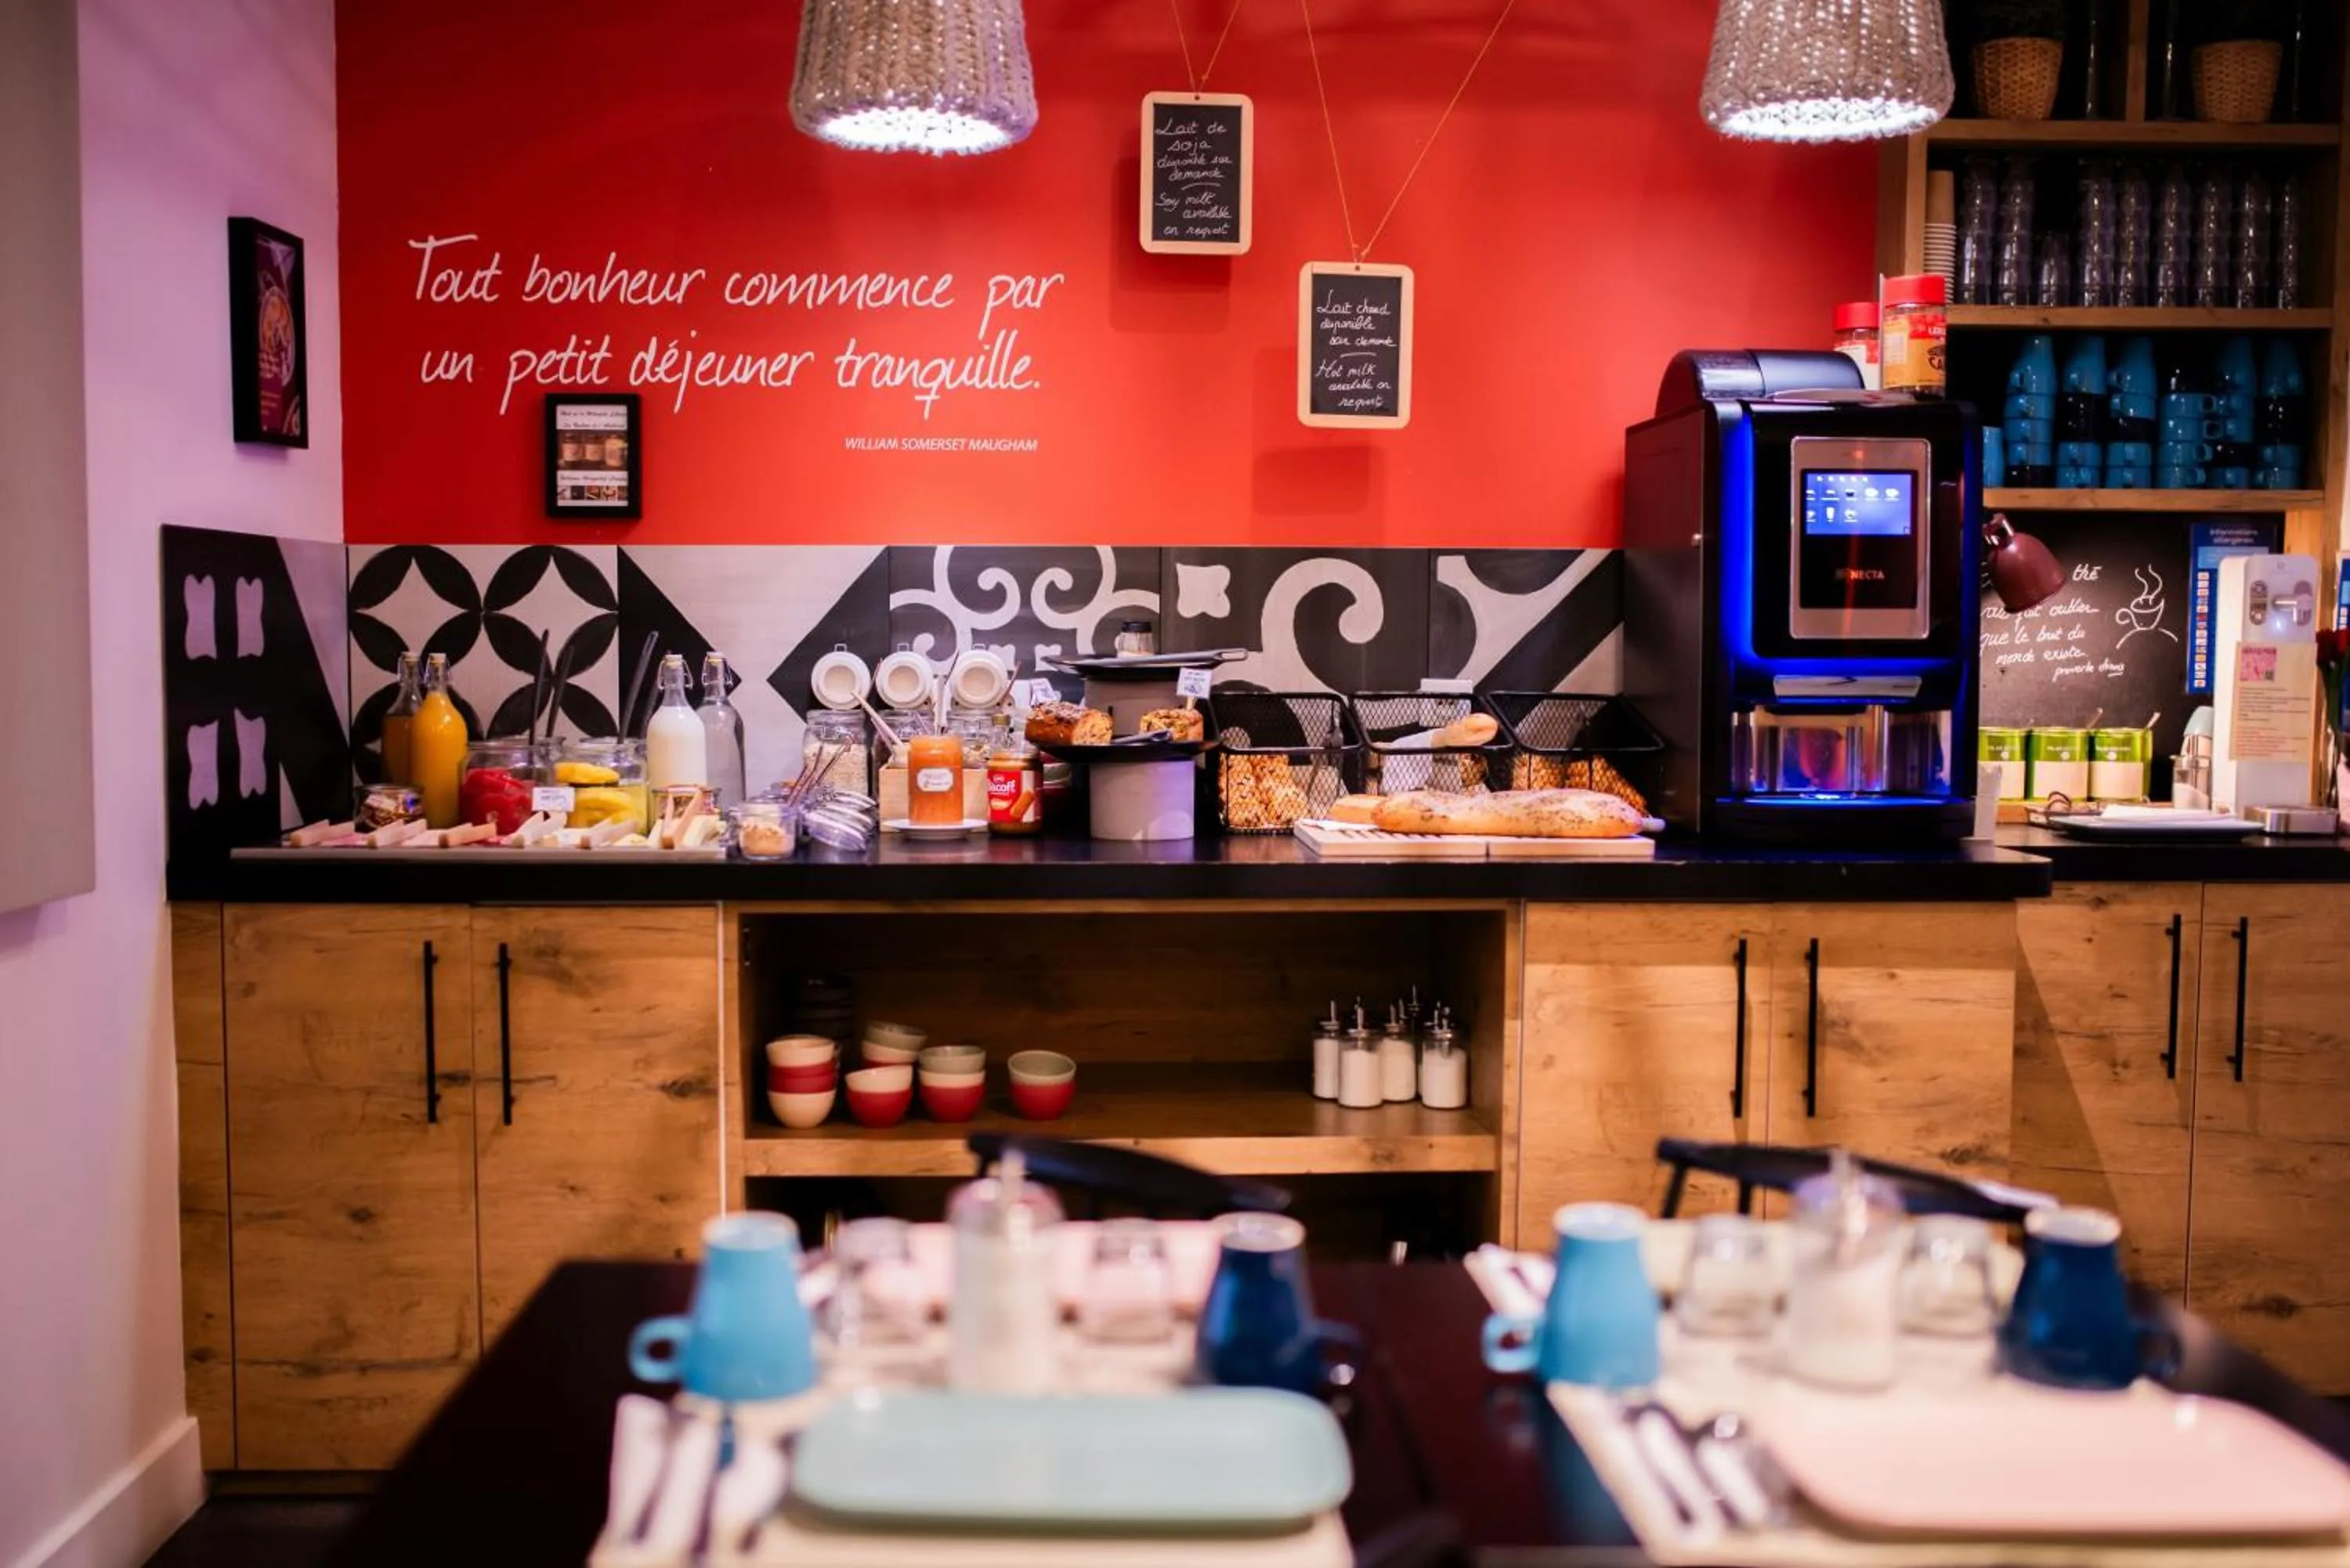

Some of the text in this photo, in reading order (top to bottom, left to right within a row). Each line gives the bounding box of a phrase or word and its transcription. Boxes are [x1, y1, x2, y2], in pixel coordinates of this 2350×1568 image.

[1155, 117, 1227, 135] Lait de
[1167, 138, 1213, 156] soja
[1155, 193, 1217, 212] Soy milk
[1163, 226, 1179, 236] on
[408, 234, 1065, 338] Tout bonheur commence par
[1316, 289, 1391, 316] Lait chaud
[1320, 316, 1376, 334] disponible
[421, 330, 1042, 419] un petit déjeuner tranquille.
[1315, 359, 1376, 378] Hot milk
[1377, 381, 1392, 389] on
[845, 437, 1038, 452] WILLIAM SOMERSET MAUGHAM
[1850, 569, 1885, 580] NECTA
[2072, 563, 2102, 581] thé
[1980, 631, 2009, 656] que
[2015, 626, 2030, 645] le
[2067, 623, 2087, 639] du
[1996, 649, 2036, 665] monde
